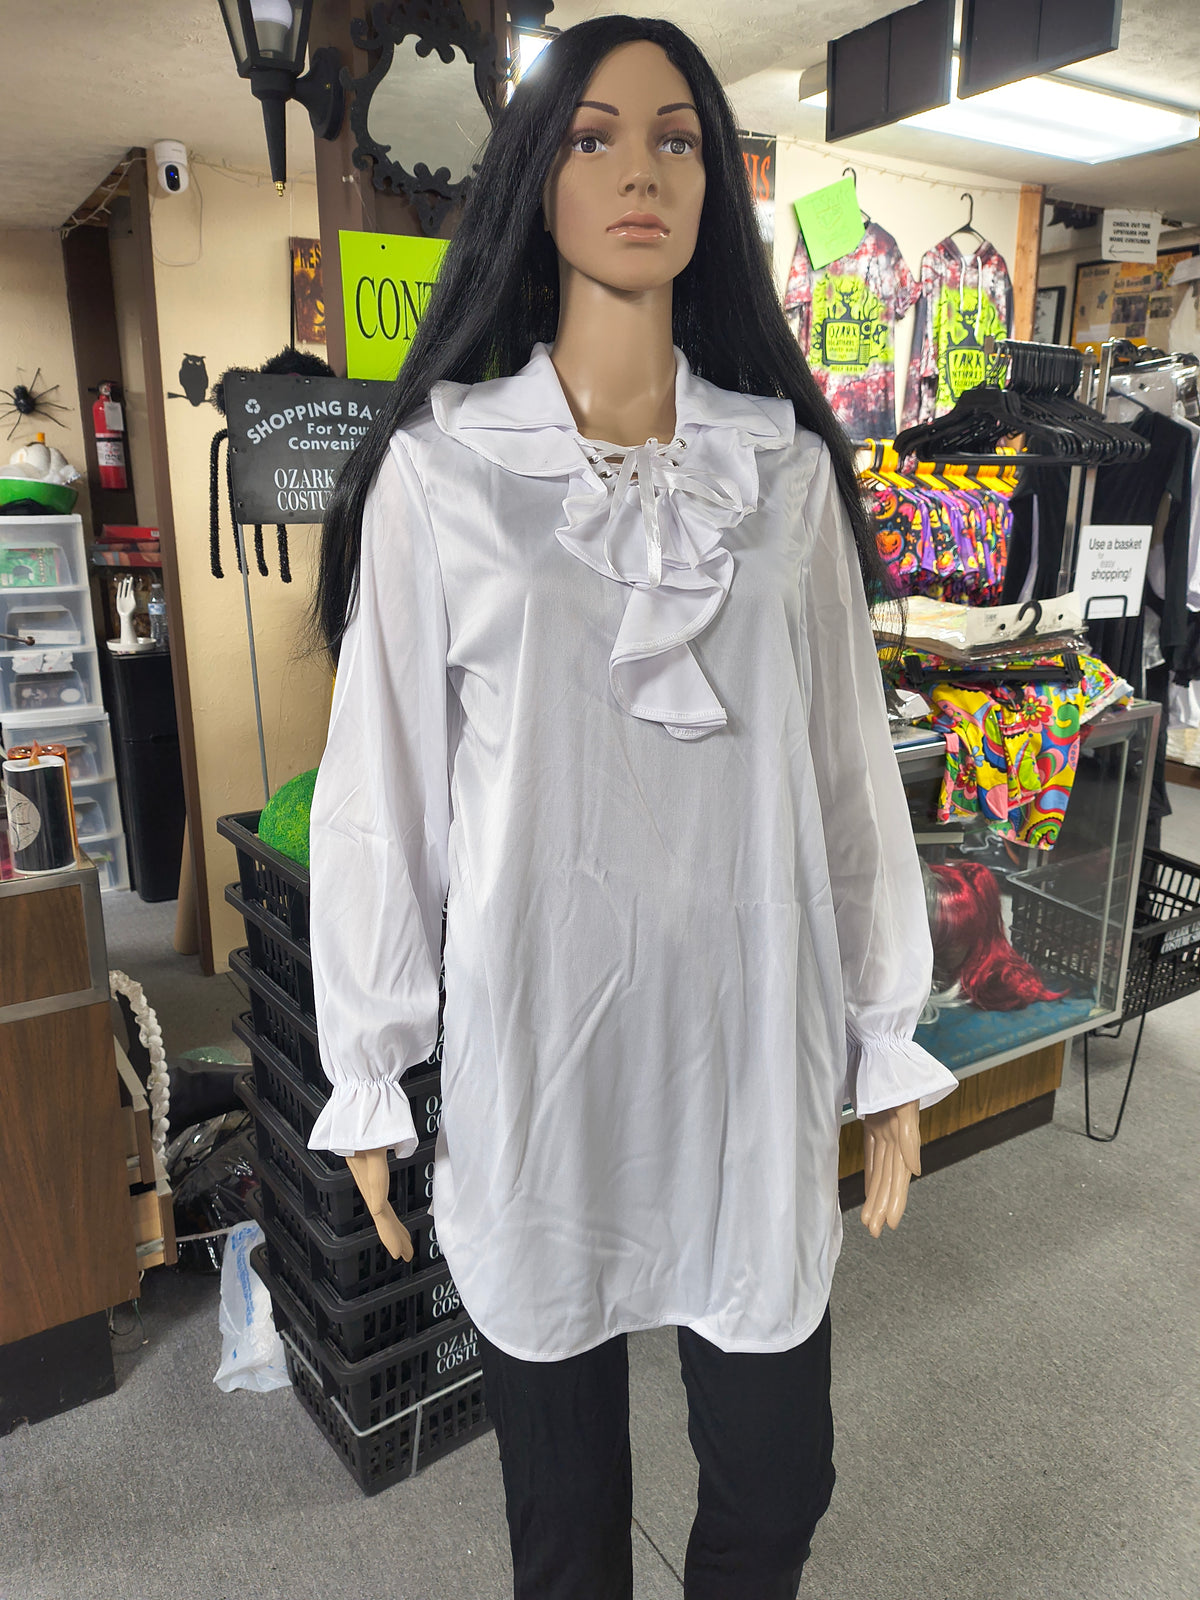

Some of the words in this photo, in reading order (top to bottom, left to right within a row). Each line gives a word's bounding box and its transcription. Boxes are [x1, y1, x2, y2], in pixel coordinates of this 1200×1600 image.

[246, 400, 342, 445] SHOPPING
[348, 401, 381, 421] BA
[307, 422, 333, 435] For
[288, 437, 360, 451] Conveni
[1089, 538, 1106, 550] Use
[1107, 540, 1112, 549] a
[1114, 538, 1142, 550] basket
[1091, 568, 1132, 582] shopping!
